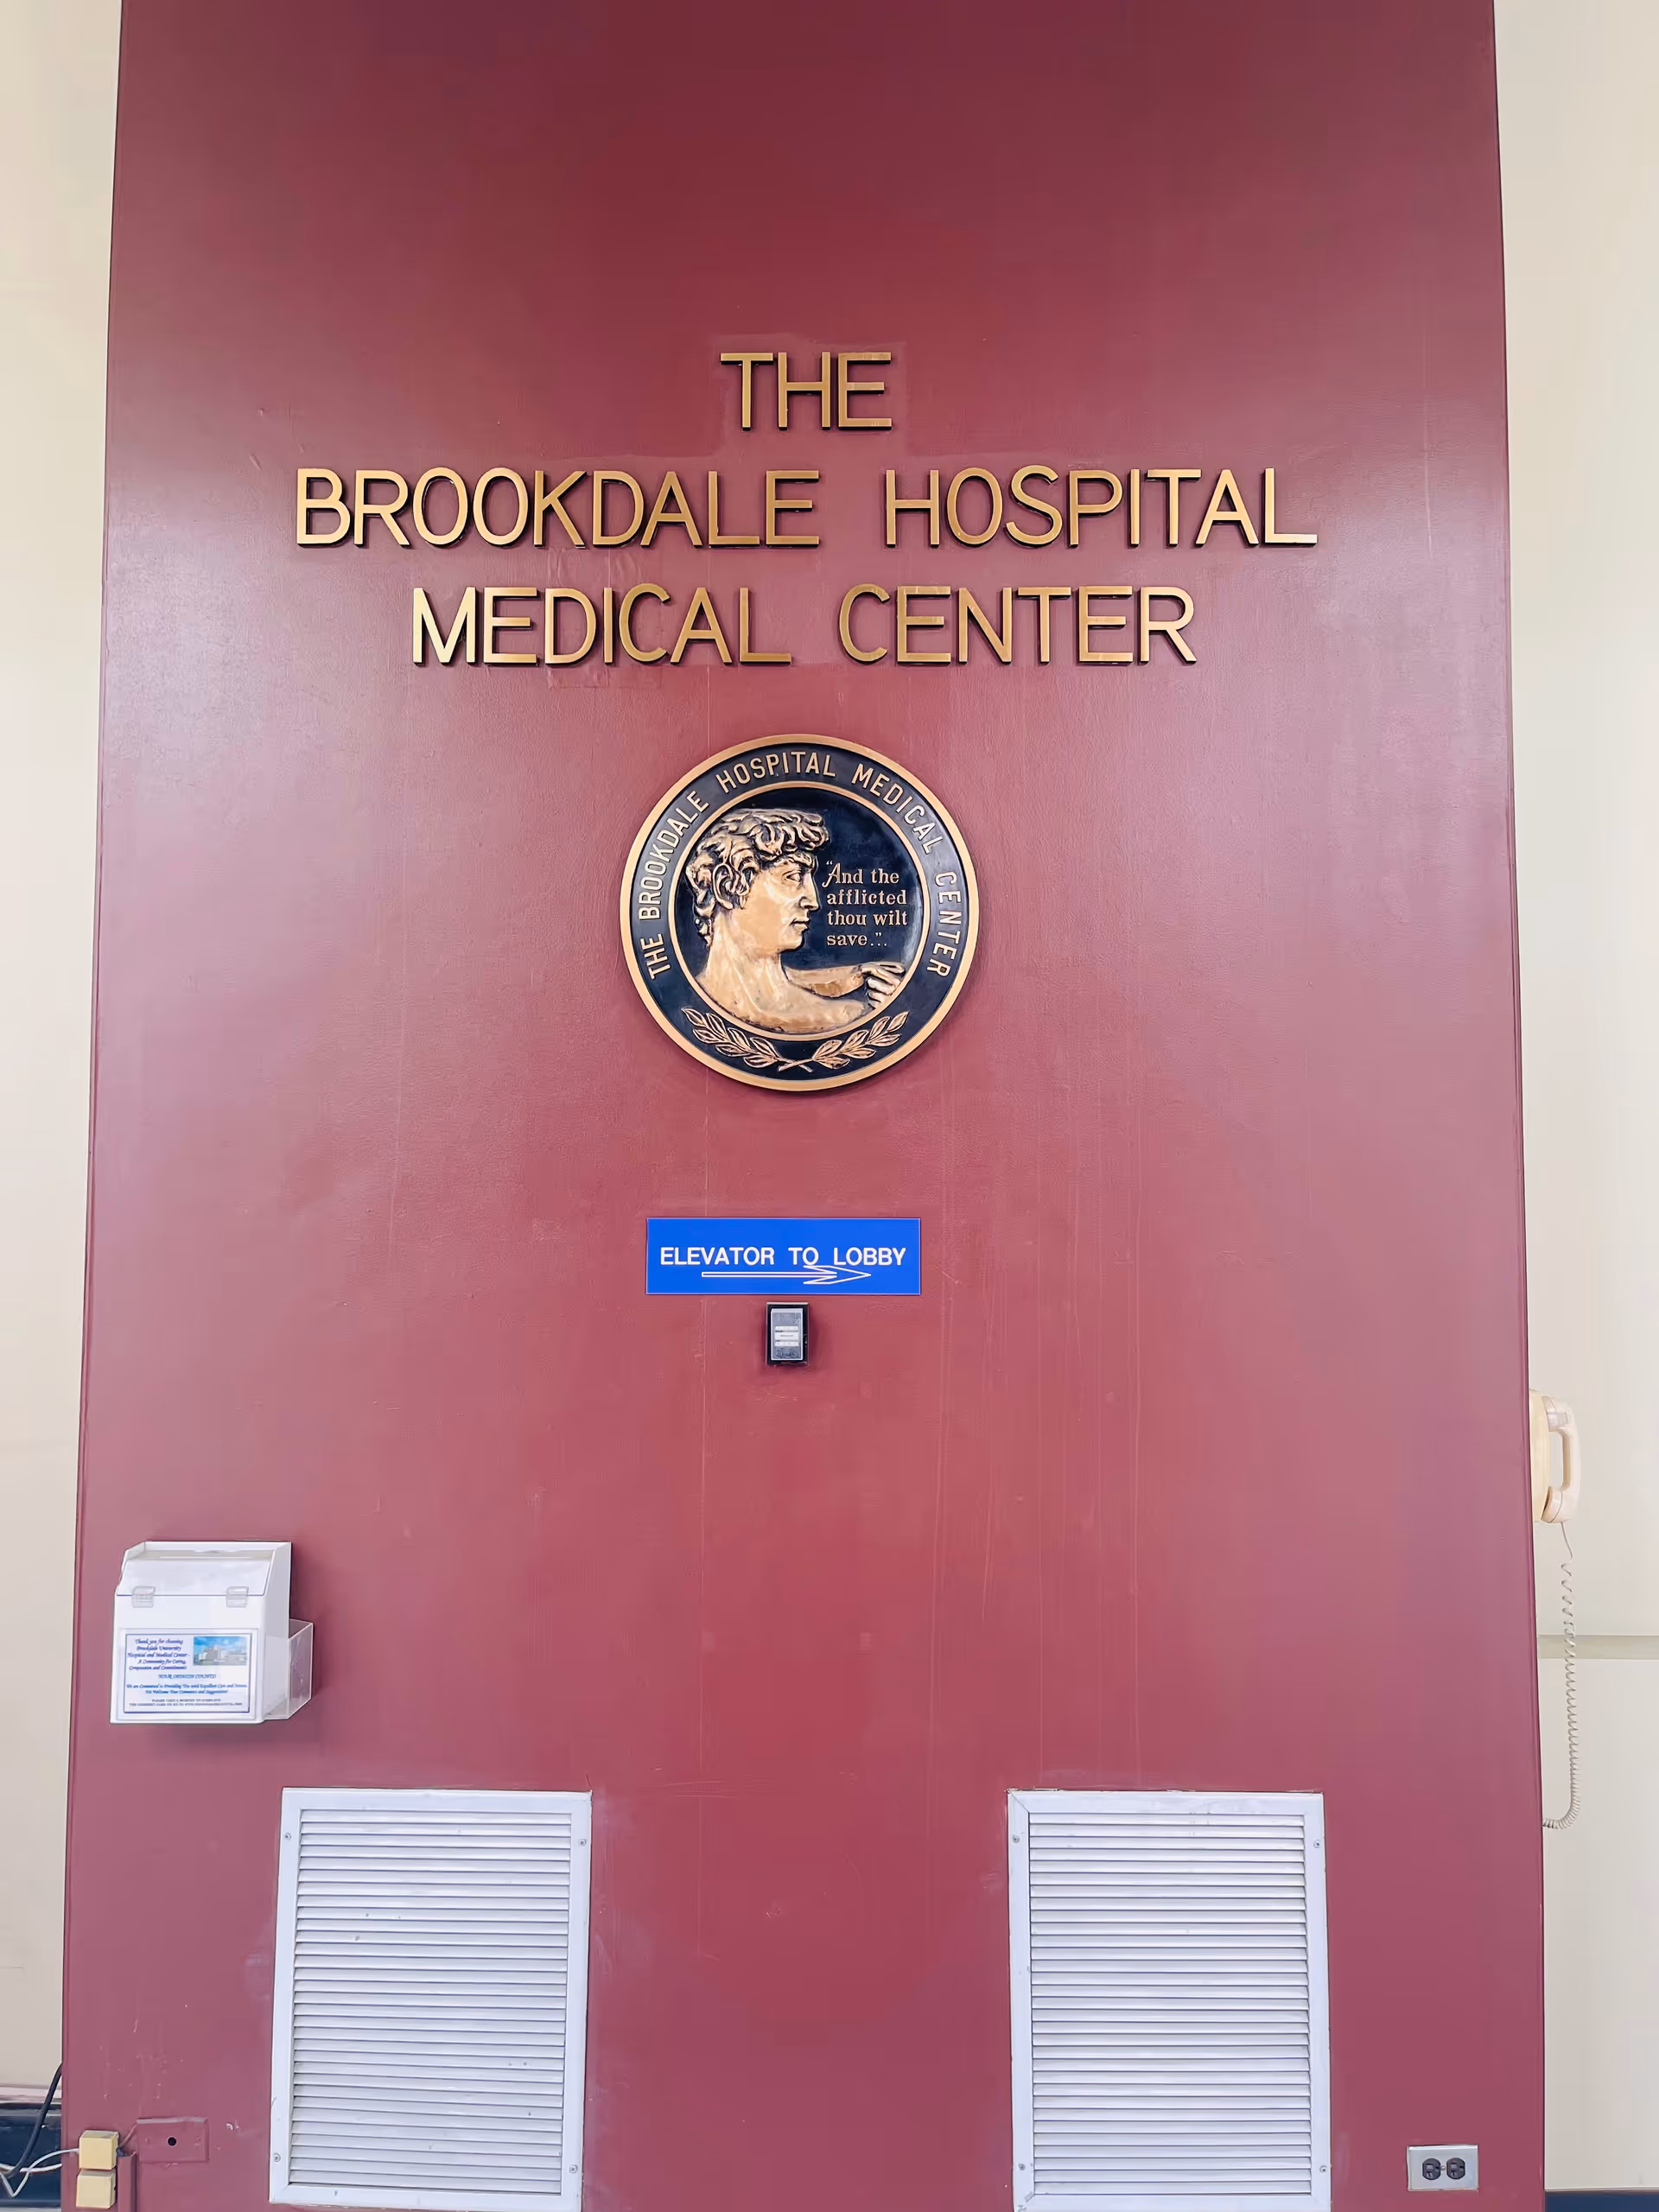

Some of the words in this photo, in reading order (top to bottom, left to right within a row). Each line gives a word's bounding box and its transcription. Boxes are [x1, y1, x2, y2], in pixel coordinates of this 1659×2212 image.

[721, 352, 893, 430] THE
[296, 467, 820, 548] BROOKDALE
[885, 465, 1318, 548] HOSPITAL
[411, 582, 792, 665] MEDICAL
[838, 583, 1198, 664] CENTER
[715, 751, 836, 794] HOSPITAL
[851, 763, 944, 855] MEDICAL
[639, 790, 709, 921] BROOKDALE
[871, 868, 899, 884] the
[826, 888, 908, 906] afflicted
[827, 909, 867, 926] thou
[873, 909, 908, 926] wilt
[926, 871, 963, 978] CENTER
[639, 933, 672, 980] THE
[660, 1247, 775, 1266] ELEVATOR
[788, 1247, 819, 1266] TO
[833, 1247, 906, 1266] LOBBY
